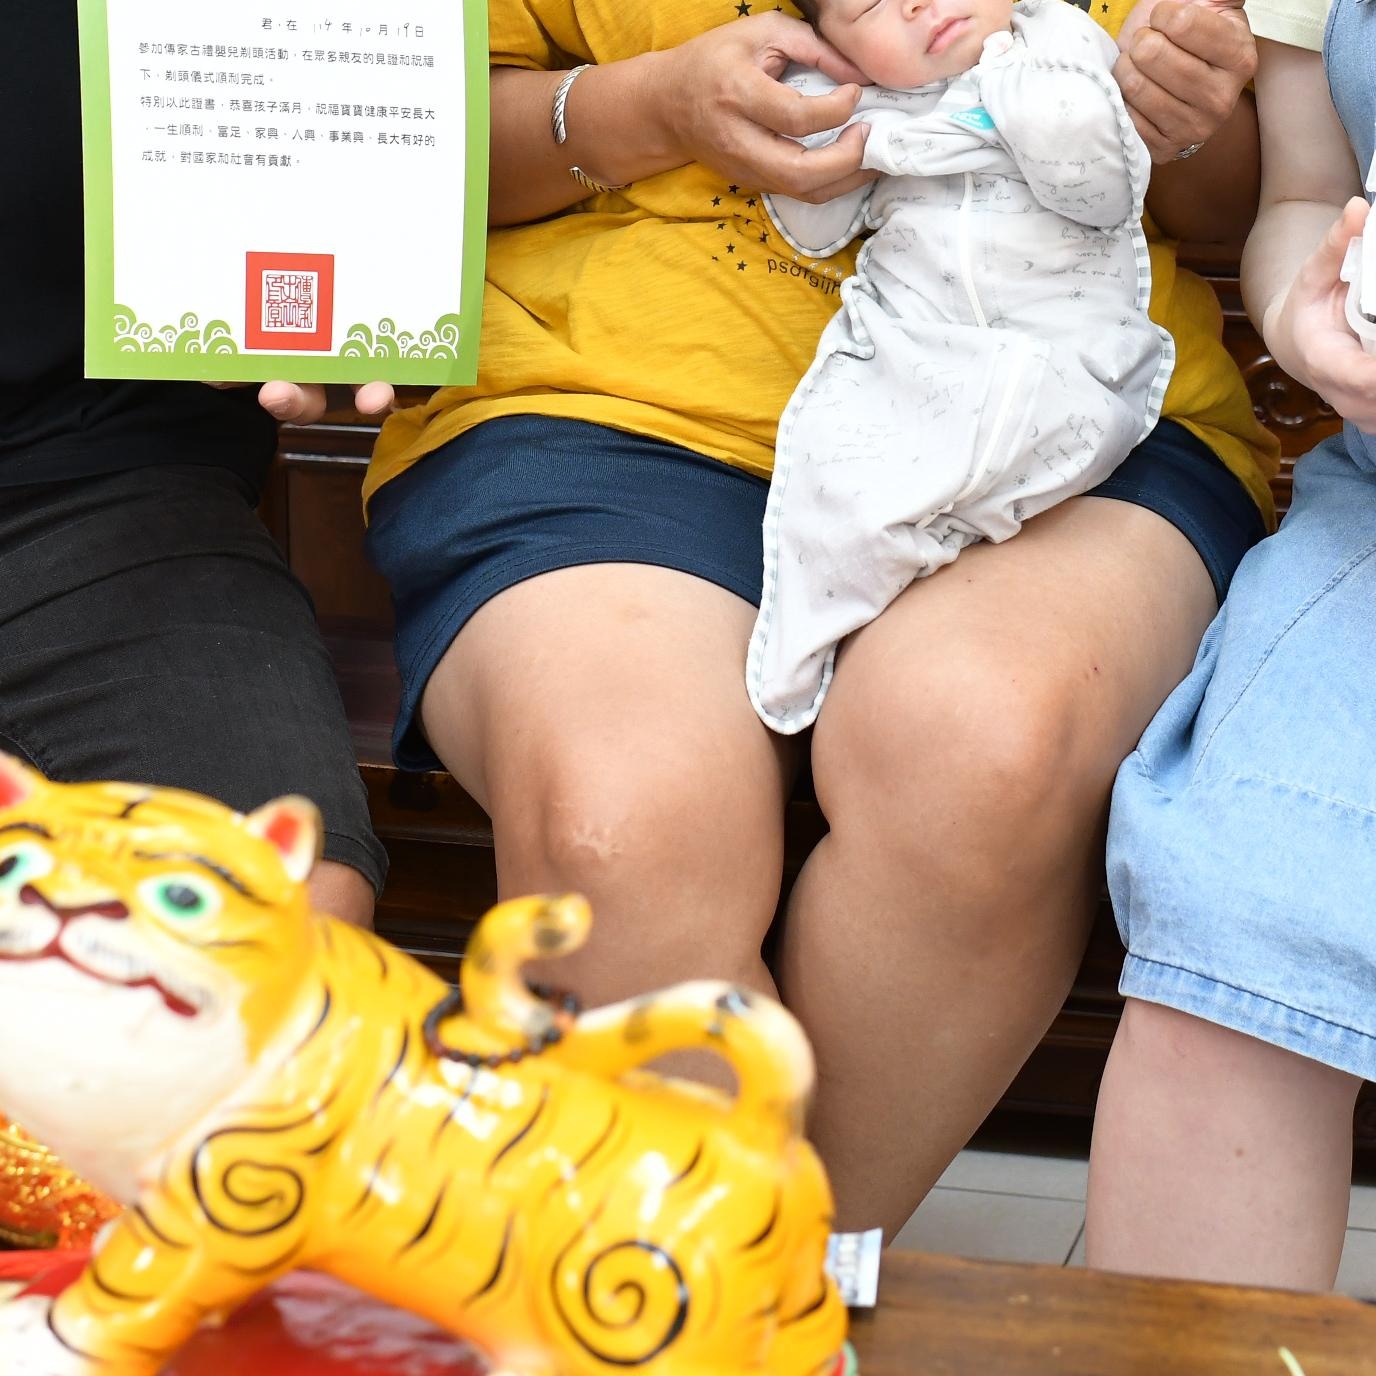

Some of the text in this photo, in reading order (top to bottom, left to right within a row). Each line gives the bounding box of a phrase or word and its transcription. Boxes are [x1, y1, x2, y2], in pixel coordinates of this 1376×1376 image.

[341, 22, 353, 34] 年
[378, 24, 388, 36] 月
[414, 25, 424, 38] 日
